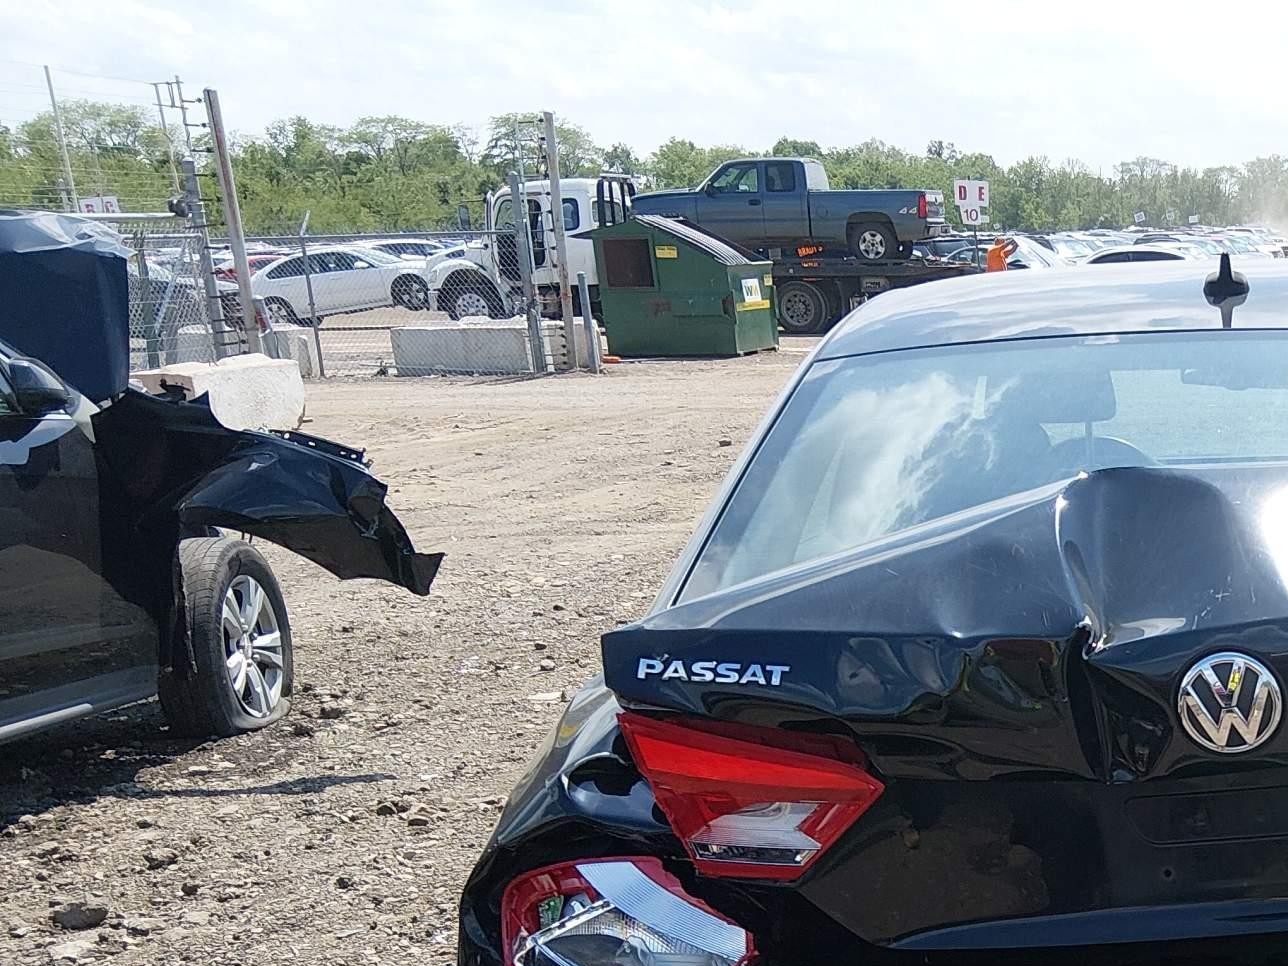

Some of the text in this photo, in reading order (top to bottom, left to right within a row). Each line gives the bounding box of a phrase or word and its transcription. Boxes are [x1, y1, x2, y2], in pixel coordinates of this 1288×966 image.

[959, 185, 985, 201] D E
[963, 208, 979, 222] 10
[637, 657, 791, 686] PASSAT
[1180, 655, 1276, 750] VW
